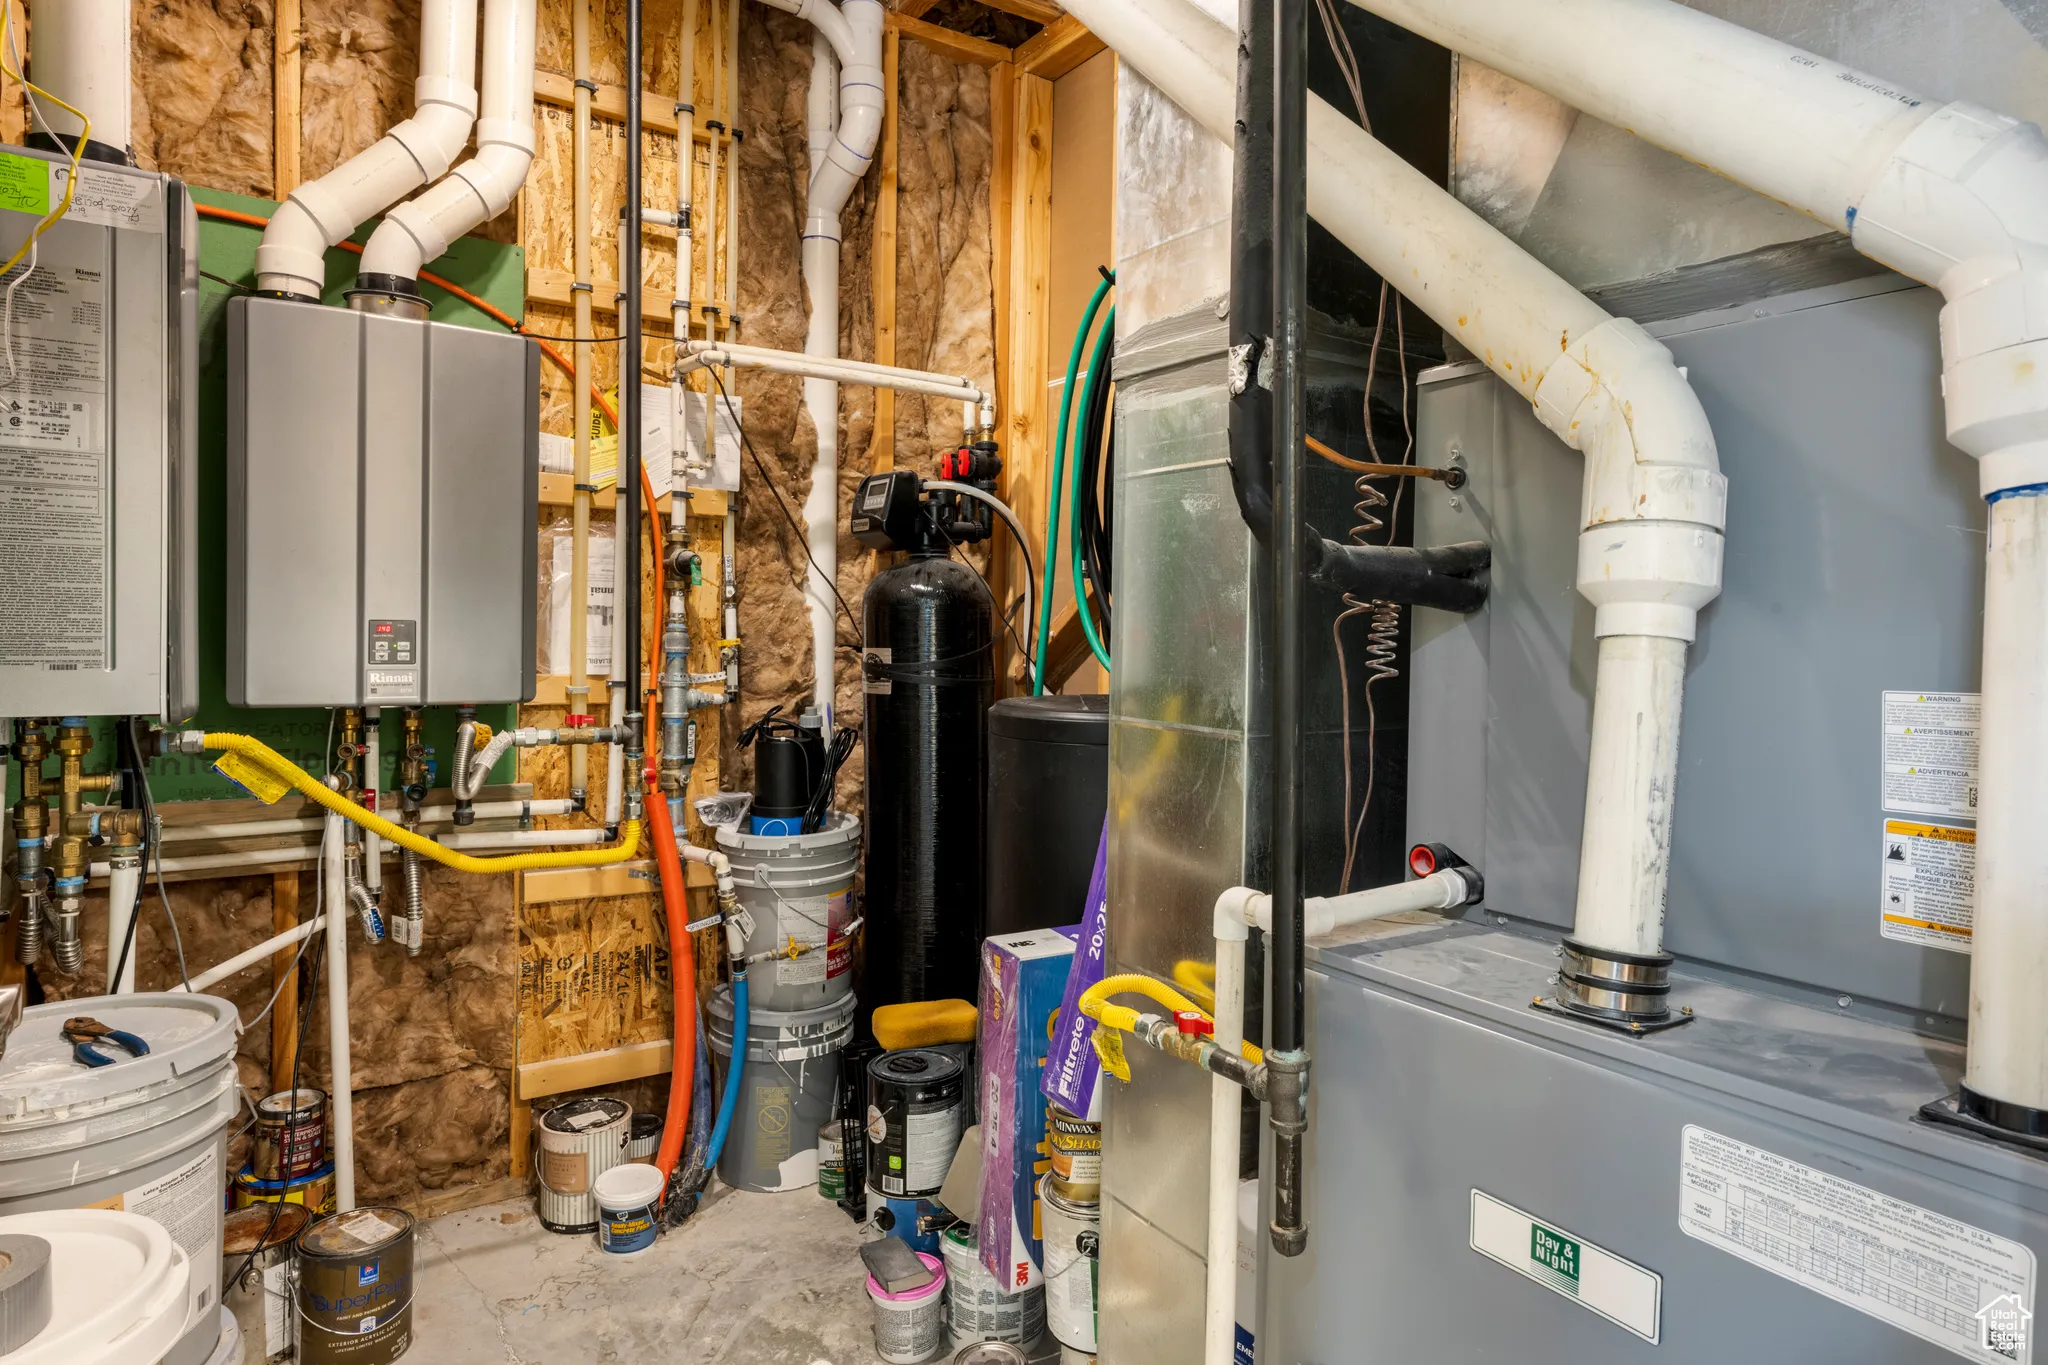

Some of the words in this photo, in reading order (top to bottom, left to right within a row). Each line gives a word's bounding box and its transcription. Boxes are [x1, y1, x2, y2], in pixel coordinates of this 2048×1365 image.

[75, 268, 101, 278] Rinnai
[591, 412, 602, 440] GUIDE
[591, 586, 614, 596] nnai
[377, 625, 391, 633] 140
[370, 673, 414, 683] Rinnai
[1913, 728, 1974, 736] AVERTISSEMENT
[1917, 768, 1969, 777] ADVERTENCIA
[1928, 832, 1976, 843] AVERTISSEM
[1944, 829, 1976, 837] WARNIN
[1922, 838, 1947, 846] HAZARD
[1914, 874, 1941, 883] RISQUE
[1942, 878, 1974, 888] D'EXPLO
[1915, 867, 1956, 878] EXPLOSION
[1958, 873, 1974, 881] HAZ
[1939, 925, 1971, 937] WARNIN
[1058, 1016, 1085, 1098] Filtrete
[1055, 1119, 1094, 1134] MINWAX
[142, 1186, 159, 1196] Latex
[160, 1176, 179, 1188] Interior
[1686, 1171, 1721, 1189] APPLIANCE
[1690, 1178, 1716, 1193] MODELS
[1703, 1132, 1740, 1151] CONVERSION
[1746, 1147, 1755, 1157] KIT
[1760, 1153, 1783, 1167] RATING
[1788, 1163, 1808, 1177] PLATE
[1822, 1176, 1875, 1201] INTERNATIONAL
[1881, 1197, 1916, 1217] COMFORT
[1923, 1213, 1964, 1234] PRODUCTS
[1971, 1230, 1993, 1245] U.S.A.
[611, 1218, 645, 1229] Ready-Mixed
[635, 1221, 650, 1232] Patch
[1536, 1229, 1560, 1251] Day
[1564, 1243, 1574, 1259] &
[1535, 1246, 1574, 1275] Night
[1016, 1262, 1029, 1287] 3M
[352, 1311, 363, 1319] AND
[364, 1307, 381, 1316] PRIMER
[388, 1299, 396, 1307] ONE
[328, 1338, 359, 1348] EXTERIOR
[360, 1329, 386, 1341] ACRYLIC
[386, 1320, 402, 1333] LATEX
[335, 1345, 355, 1354] LIFETIME
[356, 1341, 374, 1350] LIMITED
[375, 1330, 396, 1343] WARRANTY
